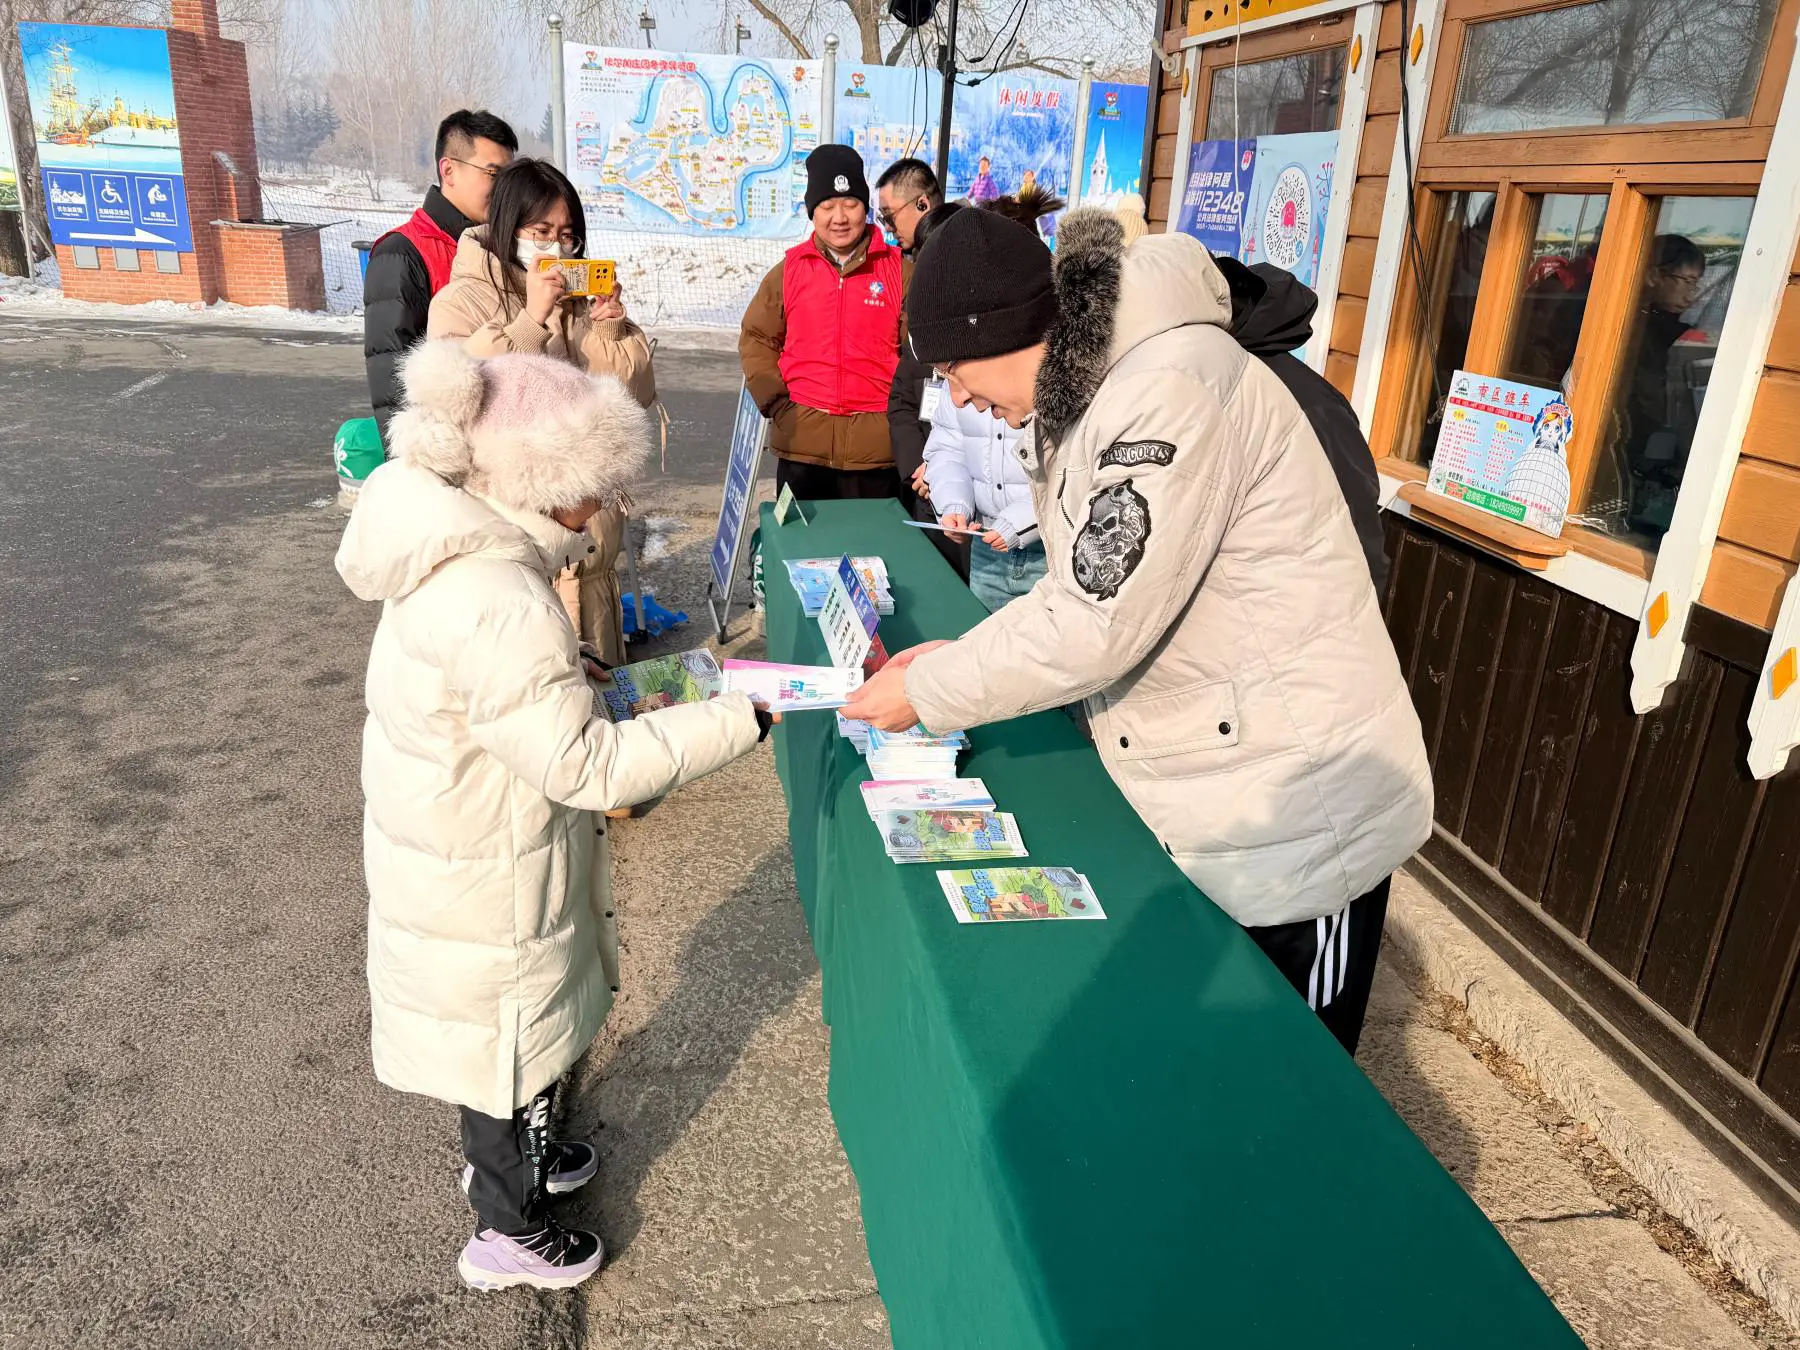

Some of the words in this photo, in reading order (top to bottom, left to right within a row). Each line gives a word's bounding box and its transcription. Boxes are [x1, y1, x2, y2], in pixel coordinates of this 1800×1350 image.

[1000, 88, 1059, 108] 休闲度假
[1478, 382, 1531, 409] 市区班车
